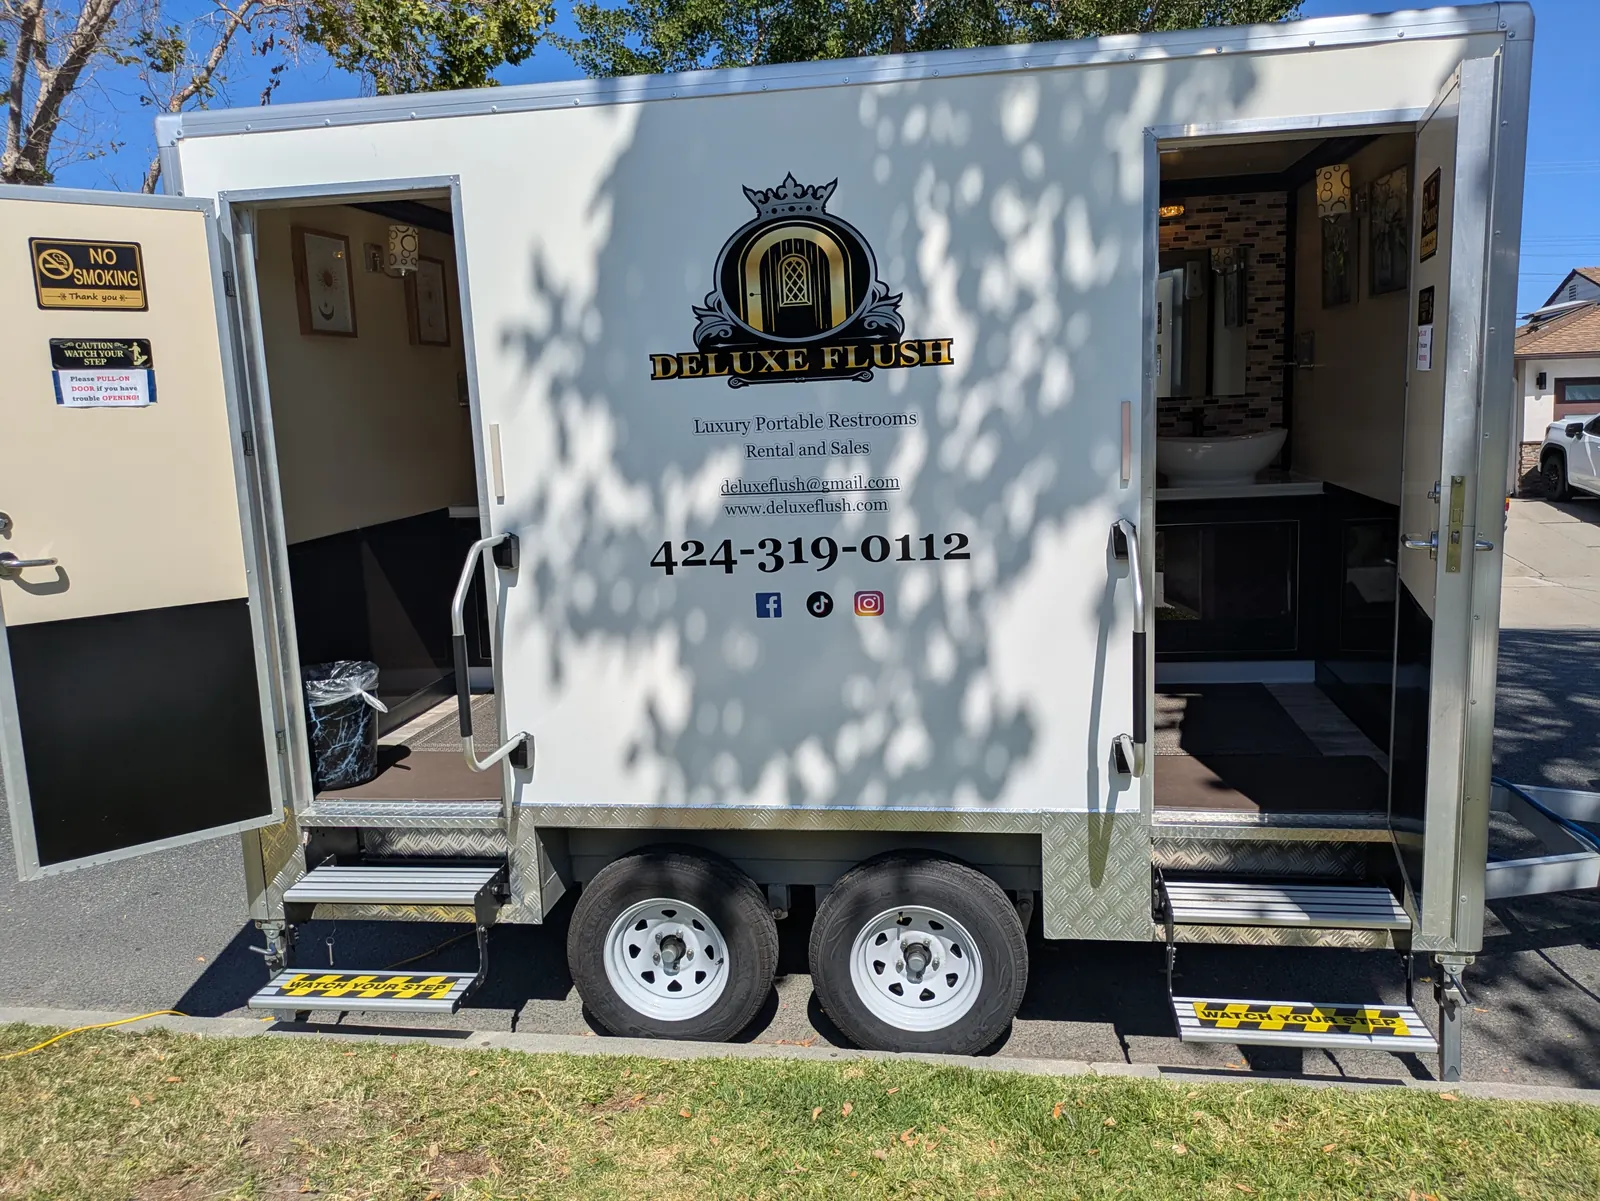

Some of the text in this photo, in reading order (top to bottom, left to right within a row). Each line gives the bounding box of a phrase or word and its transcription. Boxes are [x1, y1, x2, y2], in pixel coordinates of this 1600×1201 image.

[89, 248, 117, 264] NO
[73, 268, 139, 287] SMOKING
[69, 292, 118, 303] Thank you
[64, 350, 124, 358] WATCH YOUR
[75, 342, 114, 350] CAUTION
[83, 358, 107, 366] STEP
[650, 338, 954, 379] DELUXE FLUSH
[694, 411, 918, 436] Luxury Portable Restrooms
[745, 440, 870, 458] Rental and Sales
[720, 475, 900, 496] deluxeflush@gmail.com
[724, 498, 889, 516] www.deluxeflush.com
[650, 532, 971, 576] 424-319-0112
[289, 981, 447, 992] WATCH YOUR STEP
[1200, 1010, 1397, 1027] WATCH YOUR STEP
